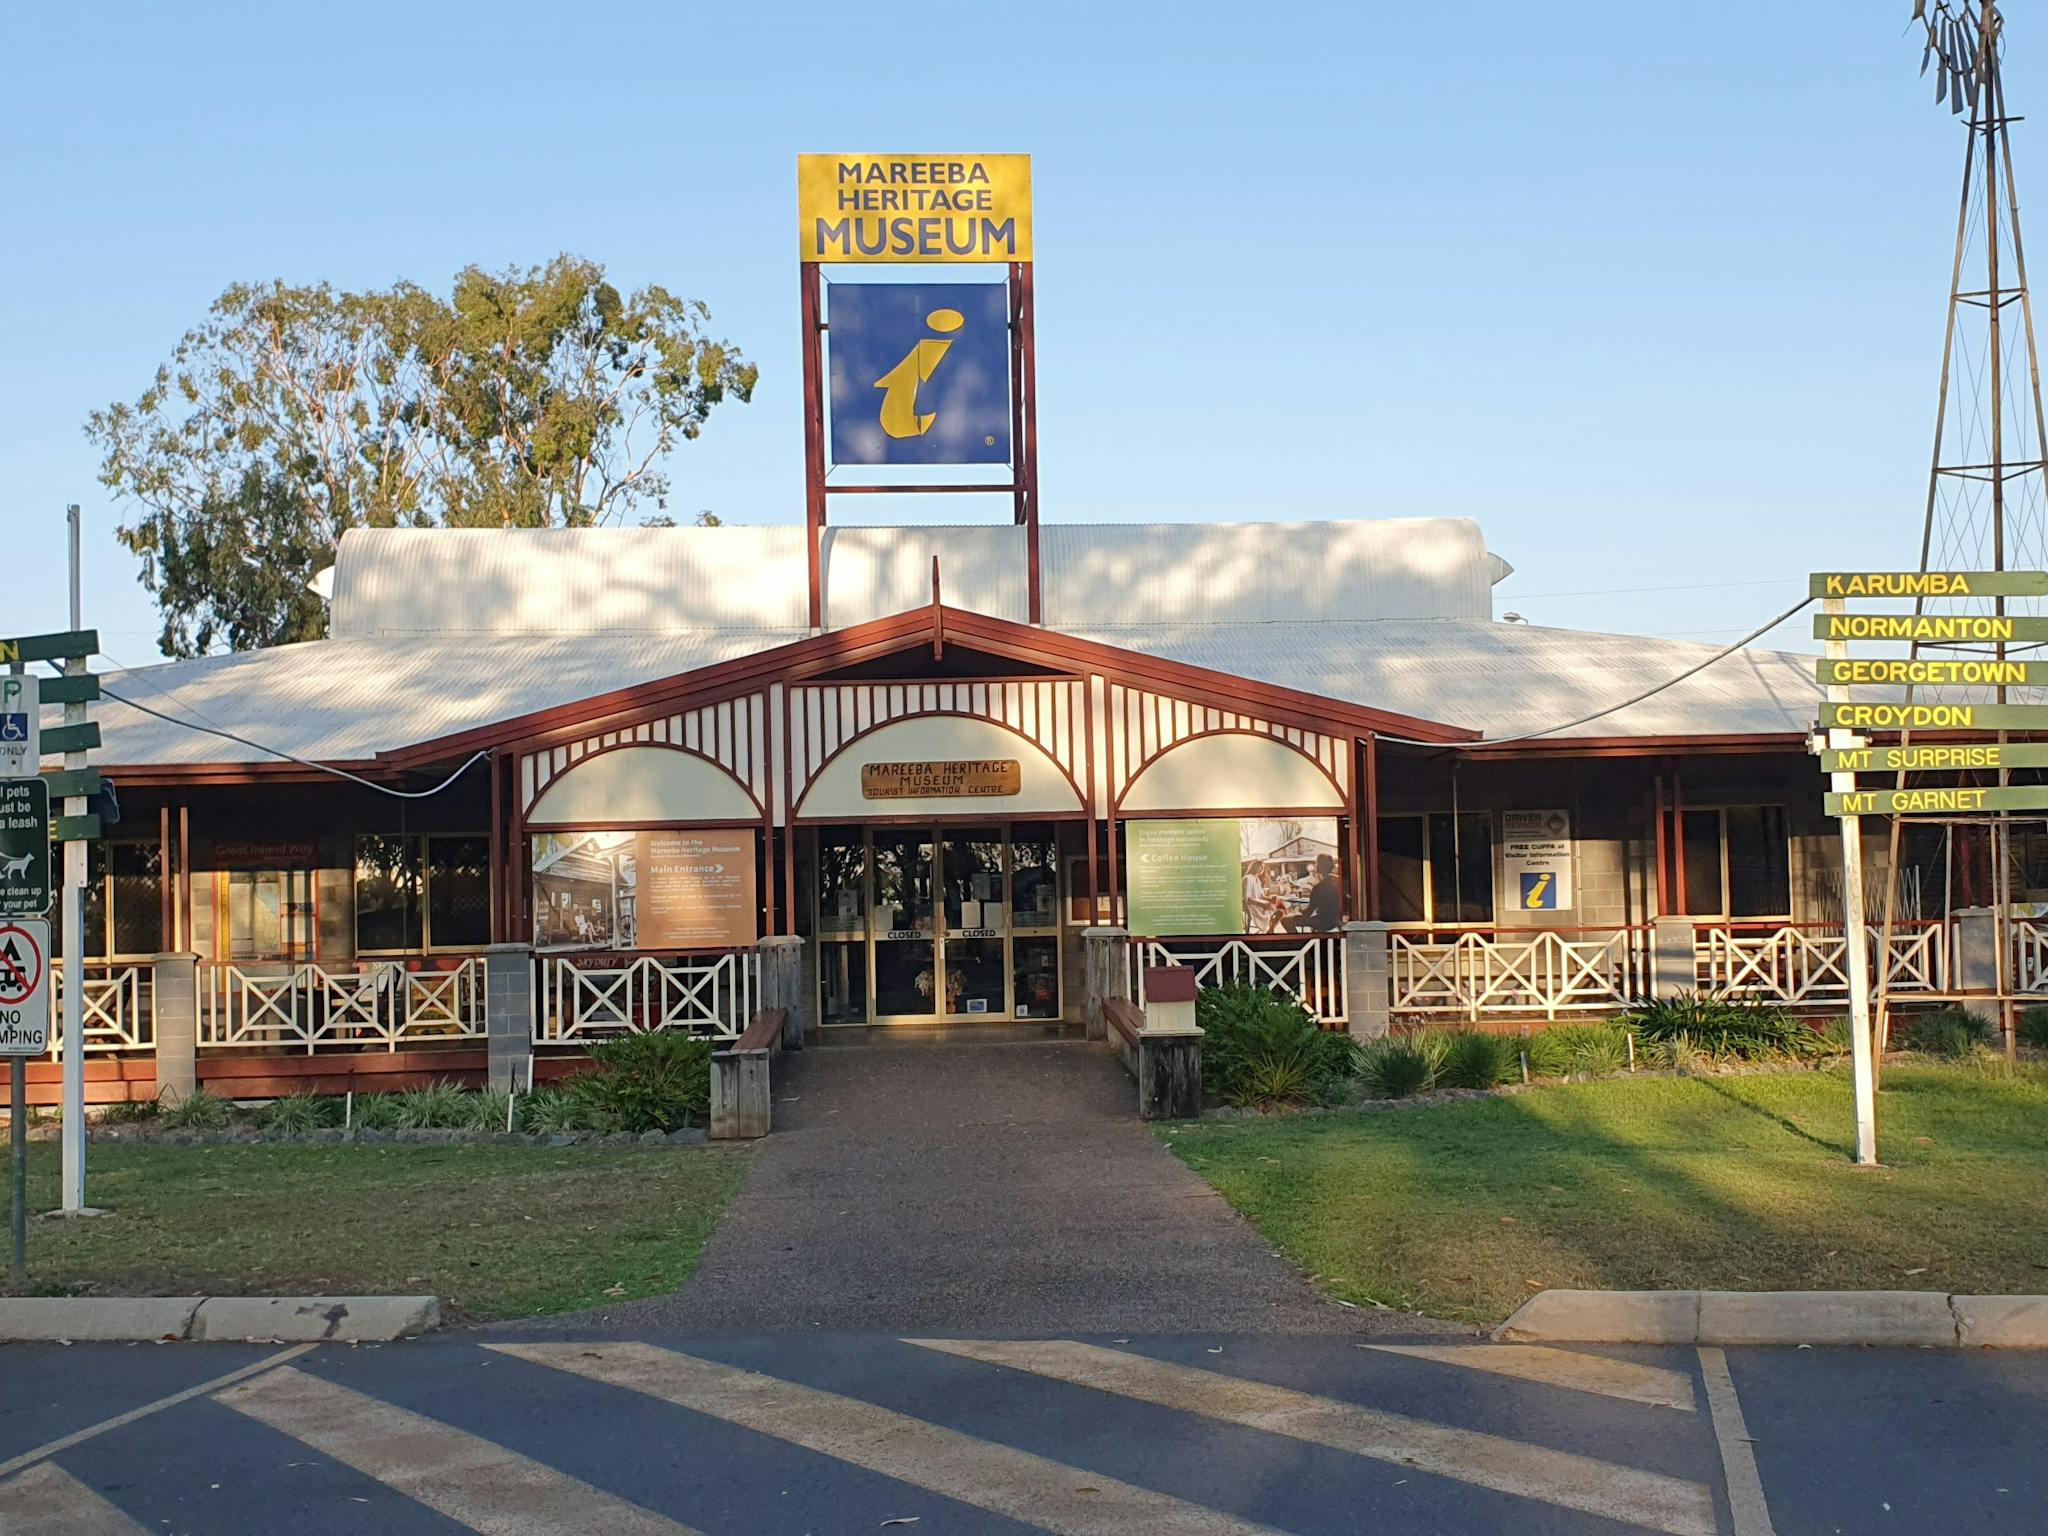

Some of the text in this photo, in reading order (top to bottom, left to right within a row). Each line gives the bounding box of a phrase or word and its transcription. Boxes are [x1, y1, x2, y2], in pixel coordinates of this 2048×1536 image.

[838, 162, 990, 184] MAREEBA
[838, 189, 992, 211] HERITAGE
[816, 217, 1015, 255] MUSEUM
[1826, 574, 1970, 595] KARUMBA
[1830, 616, 2012, 639] NORMANTON
[1833, 661, 2025, 683] GEORGETOWN
[4, 680, 21, 703] P
[1836, 705, 1971, 727] CROYDON
[0, 746, 27, 756] ONLY
[1838, 748, 2000, 769] MT SURPRISE
[870, 762, 1007, 776] MAREEBA HERITAGE
[900, 775, 964, 786] MUSEUM
[6, 786, 30, 801] pets
[867, 787, 904, 796] TOURIST
[908, 786, 960, 794] INFORMATION
[17, 801, 31, 813] be
[1842, 790, 1986, 812] MT GARNET
[9, 816, 38, 829] leash
[1151, 854, 1208, 862] Coffee House
[1529, 851, 1570, 859] Information
[650, 864, 715, 874] Main Entrance
[7, 887, 29, 896] clean
[31, 888, 42, 898] up
[3, 899, 37, 911] your pet
[887, 931, 921, 940] CLOSED
[962, 929, 996, 938] CLOSED
[0, 1010, 21, 1024] NO
[0, 1030, 42, 1044] MPING
